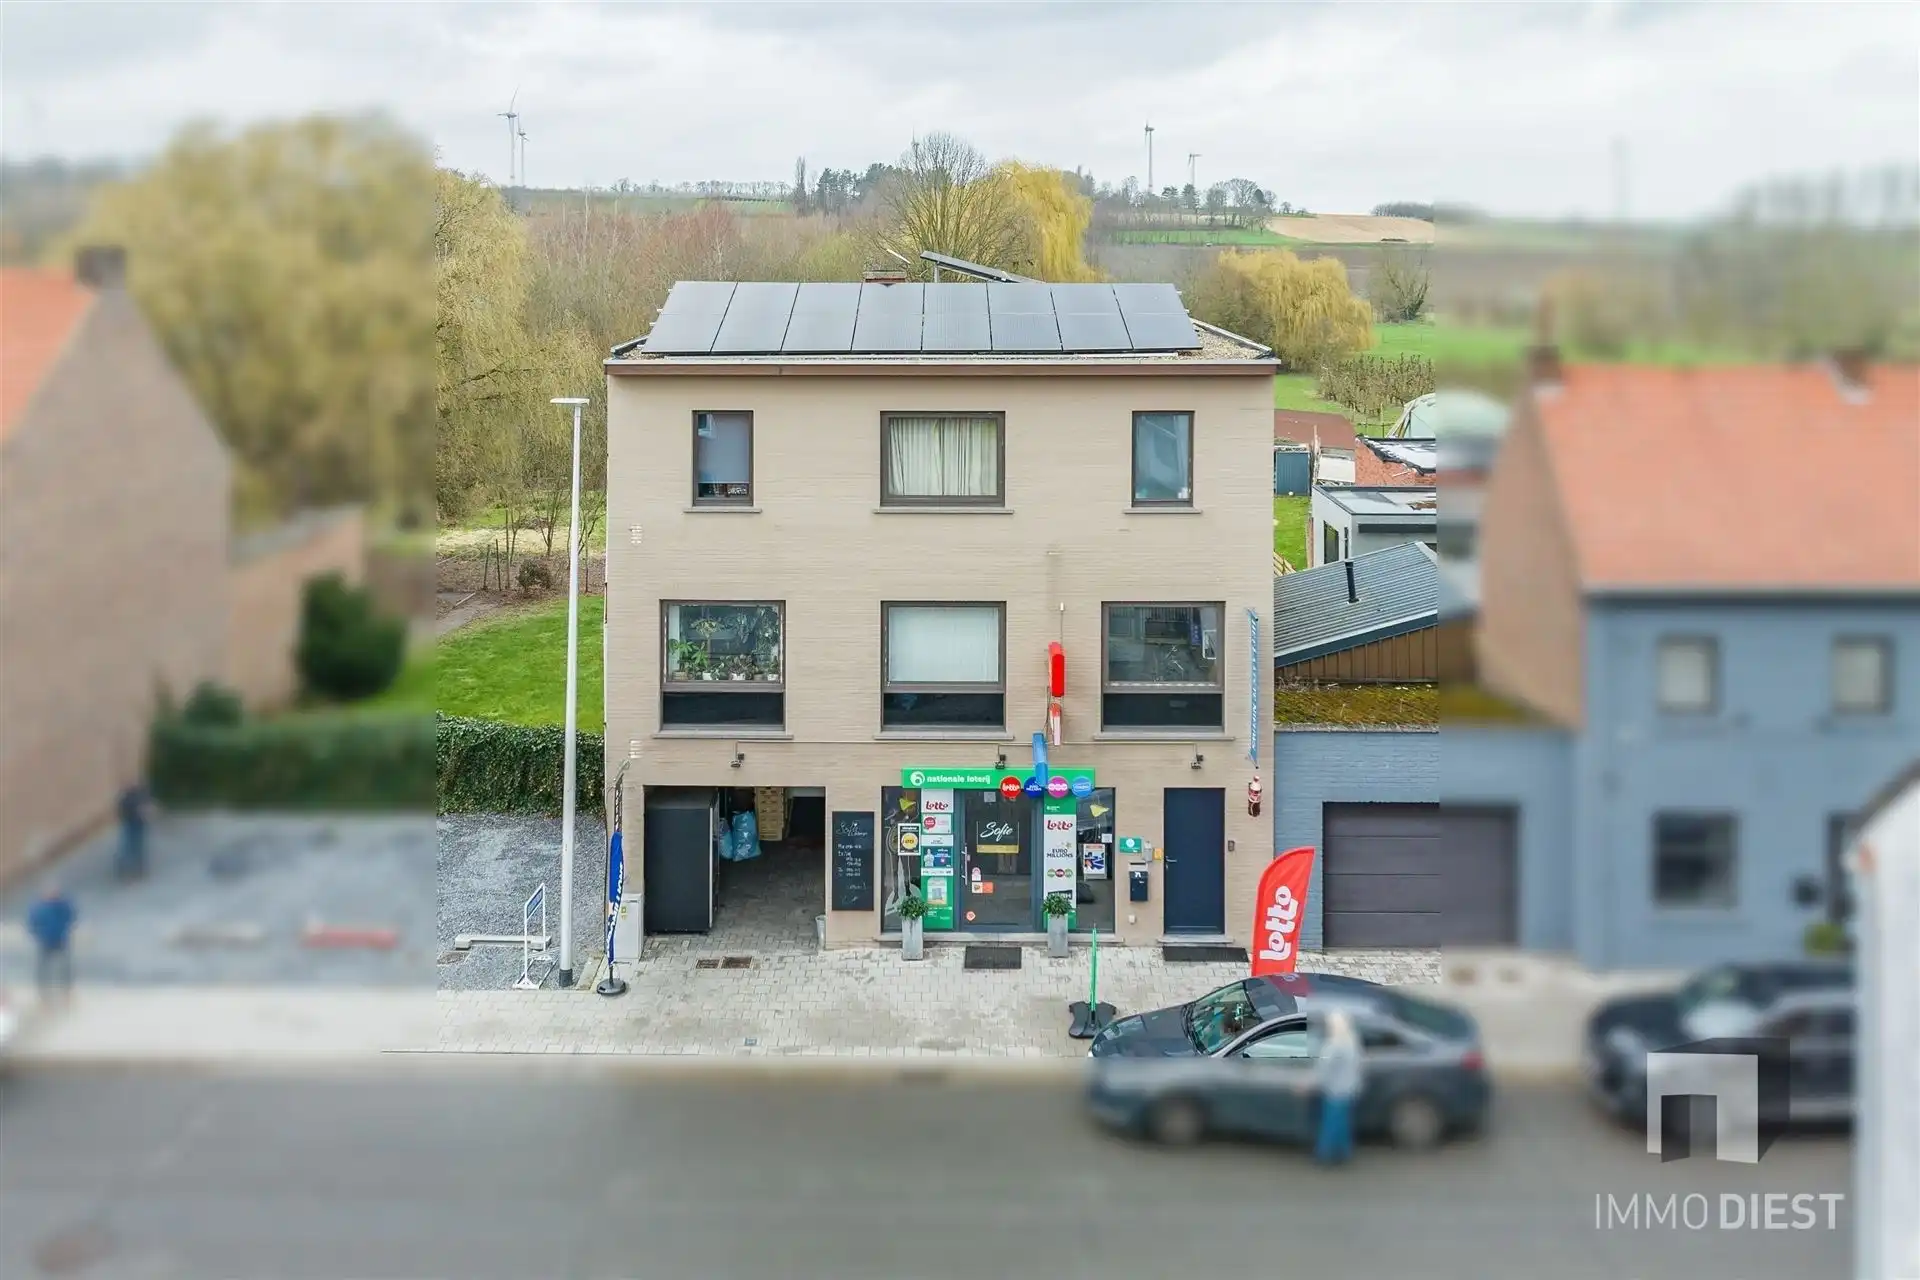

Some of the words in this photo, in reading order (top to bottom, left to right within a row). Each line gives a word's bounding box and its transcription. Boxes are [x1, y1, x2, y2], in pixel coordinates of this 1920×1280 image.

[927, 775, 965, 783] nationale
[967, 775, 991, 785] loterij
[980, 821, 1013, 842] Sofie
